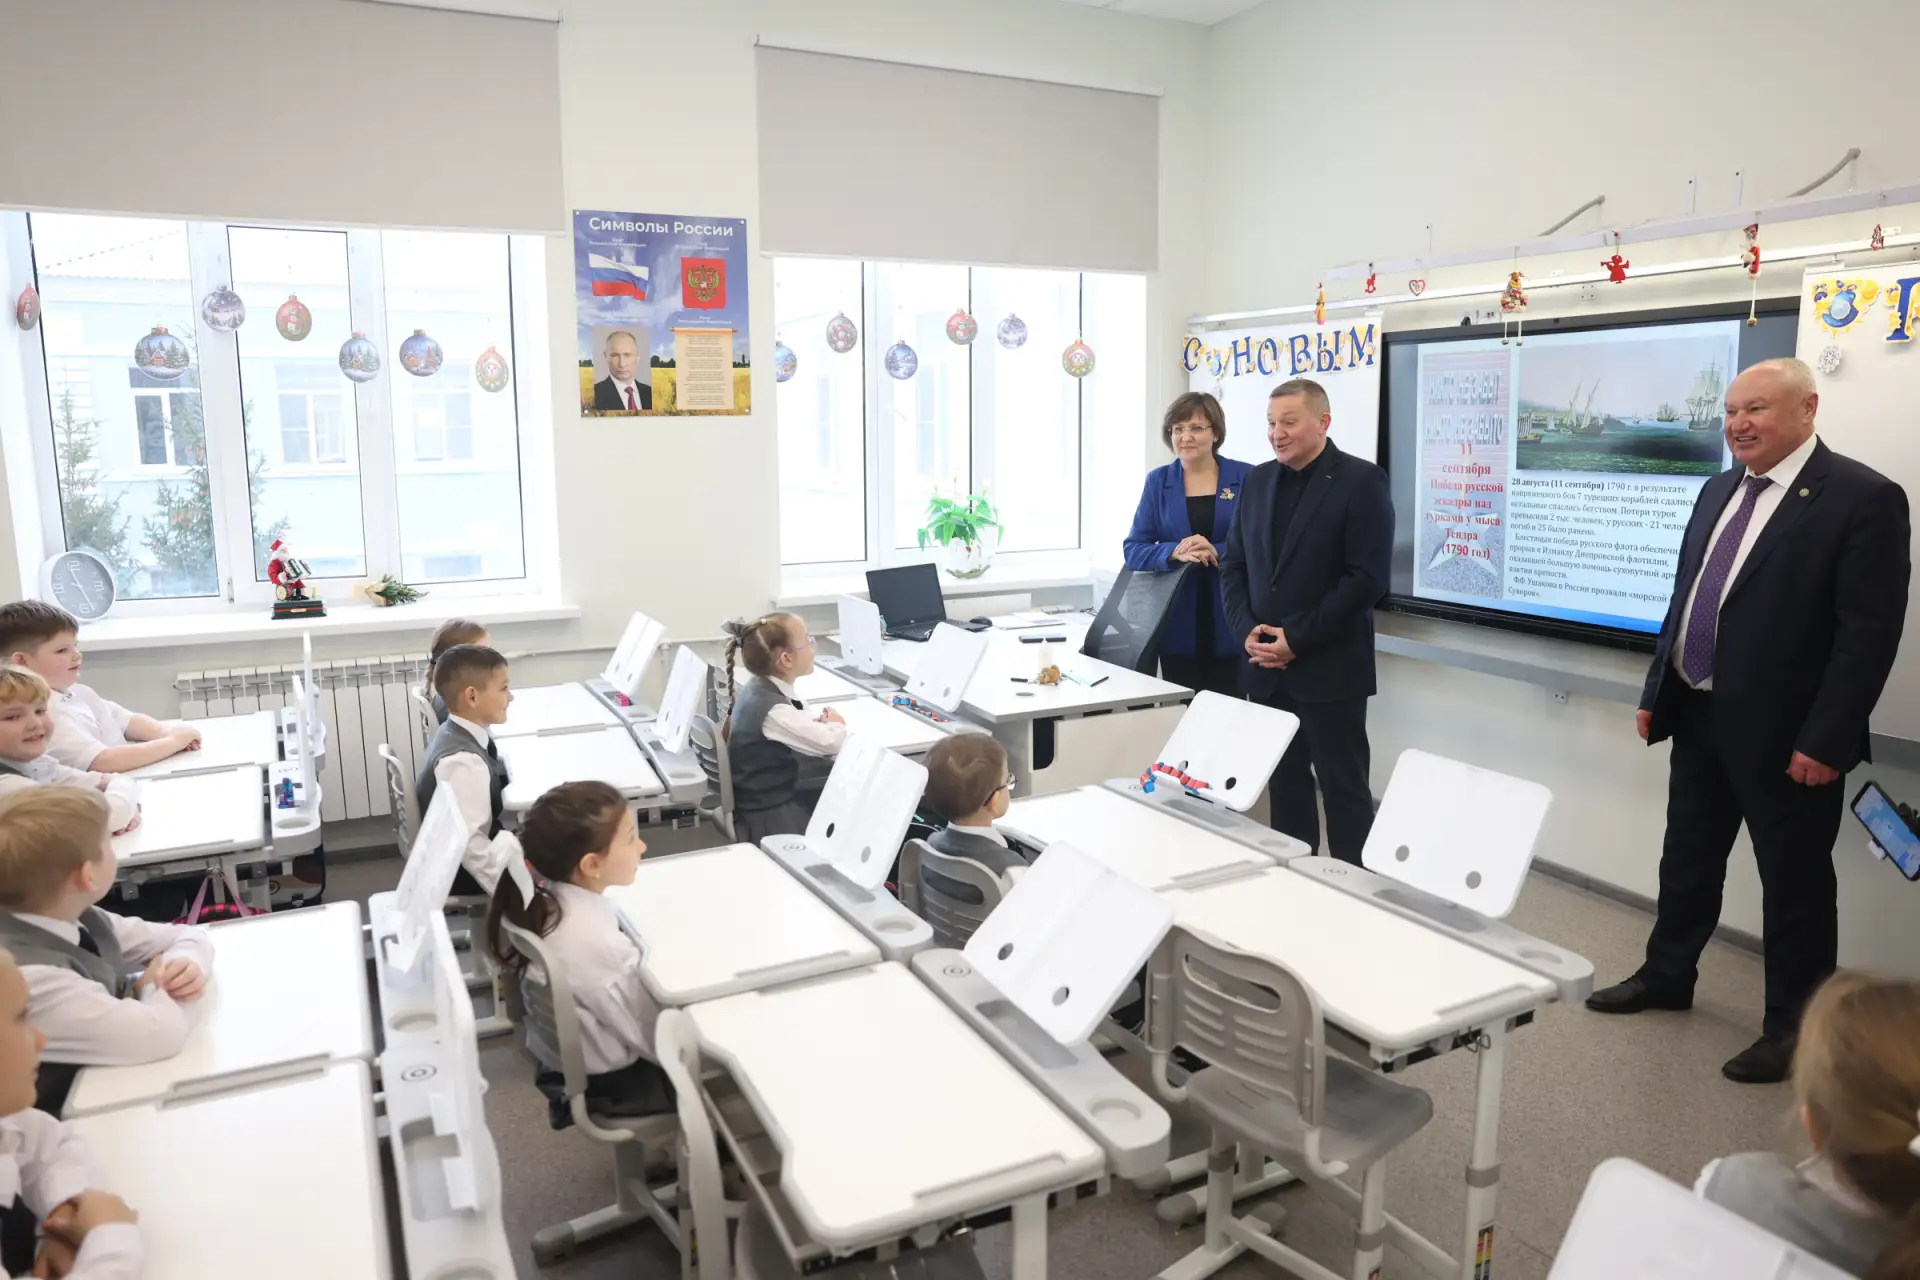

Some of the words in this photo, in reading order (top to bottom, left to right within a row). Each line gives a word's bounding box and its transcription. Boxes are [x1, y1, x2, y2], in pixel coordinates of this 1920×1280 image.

[589, 217, 668, 234] Символы
[674, 221, 733, 237] России
[1231, 324, 1375, 377] НОВЫМ
[1460, 443, 1473, 455] 11
[1443, 463, 1491, 477] сентября
[1430, 479, 1463, 490] Победа
[1464, 482, 1504, 493] русской
[1512, 478, 1521, 486] 28
[1522, 480, 1549, 488] августа
[1551, 479, 1563, 488] (11
[1564, 481, 1605, 491] сентября)
[1607, 482, 1625, 491] 1790
[1641, 484, 1687, 494] результате
[1475, 500, 1492, 509] над
[1511, 489, 1561, 499] напряженного
[1584, 494, 1619, 503] турецких
[1621, 496, 1659, 505] кораблей
[1511, 501, 1548, 510] остальные
[1621, 506, 1650, 518] Потери
[1652, 510, 1677, 519] турок
[1466, 515, 1472, 526] у
[1475, 516, 1501, 526] мыса
[1511, 512, 1548, 520] превысили
[1613, 519, 1643, 528] русских
[1650, 520, 1659, 529] 21
[1538, 524, 1546, 532] 25
[1445, 528, 1478, 541] Тендра
[1553, 536, 1579, 546] победа
[1580, 539, 1613, 549] русского
[1614, 541, 1638, 551] флота
[1442, 544, 1469, 556] (1790
[1472, 548, 1491, 560] год)
[1509, 544, 1535, 554] прорыв
[1543, 546, 1574, 557] Измаилу
[1575, 549, 1625, 562] Днепровской
[1626, 554, 1670, 567] флотилии,
[1547, 557, 1581, 570] большую
[1582, 562, 1612, 573] помощь
[1613, 566, 1659, 577] сухопутной
[1527, 577, 1557, 588] Ушакова
[1564, 582, 1590, 592] России
[1591, 587, 1627, 598] прозвали
[1629, 591, 1667, 602] «морской
